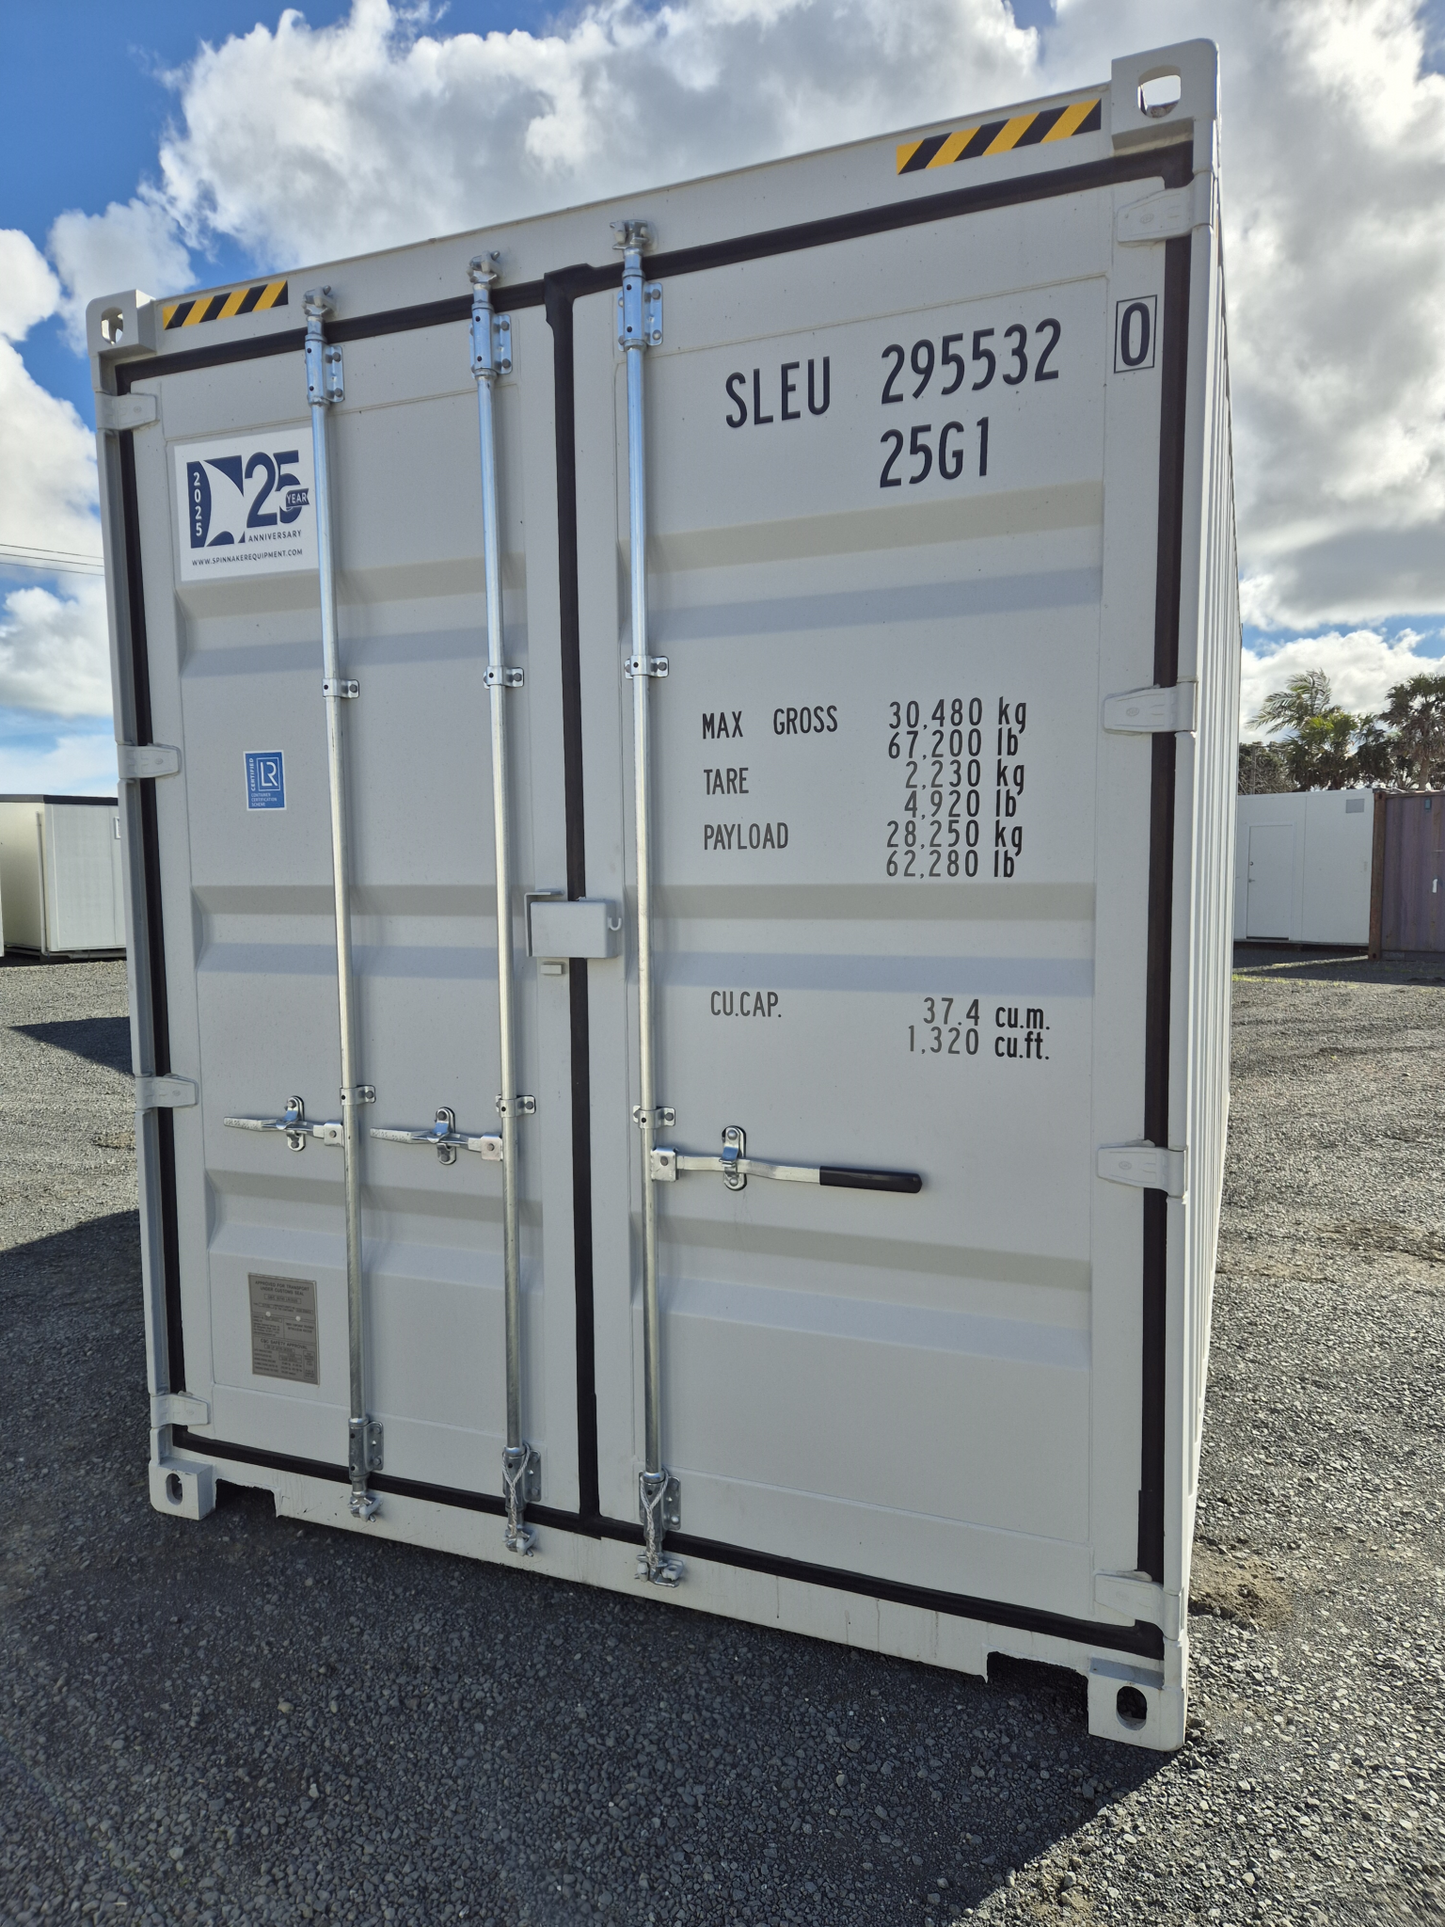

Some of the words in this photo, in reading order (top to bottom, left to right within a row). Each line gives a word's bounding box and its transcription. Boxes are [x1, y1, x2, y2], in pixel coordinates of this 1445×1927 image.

[725, 356, 831, 429] SLEU
[881, 317, 1062, 405] 295532
[879, 416, 990, 488] 25G1
[193, 472, 203, 537] 2025
[244, 449, 303, 529] 25
[286, 492, 308, 505] YEAR
[248, 529, 302, 543] ANNIVERSARY
[192, 548, 303, 566] WWW.SPINNAKEREQUIPMENT.COM
[702, 710, 744, 740] MAX
[773, 705, 838, 735] GROSS
[889, 697, 983, 730] 30,480
[998, 696, 1027, 734] kg
[888, 728, 982, 760] 67,200
[997, 727, 1019, 757] lb
[260, 761, 279, 787] LR
[704, 767, 749, 795] TARE
[905, 759, 981, 790] 2,230
[996, 758, 1025, 796] kg
[904, 789, 980, 820] 4,920
[995, 788, 1017, 818] lb
[704, 822, 789, 850] PAYLOAD
[887, 819, 980, 850] 28,250
[994, 819, 1023, 857] kg
[886, 849, 979, 880] 62,280
[993, 848, 1015, 878] lb
[710, 990, 782, 1018] CU.CAP.
[923, 997, 980, 1026] 37.4
[995, 1006, 1051, 1030] cu.m.
[908, 1024, 980, 1056] 1,320
[994, 1031, 1050, 1060] cu.ft.
